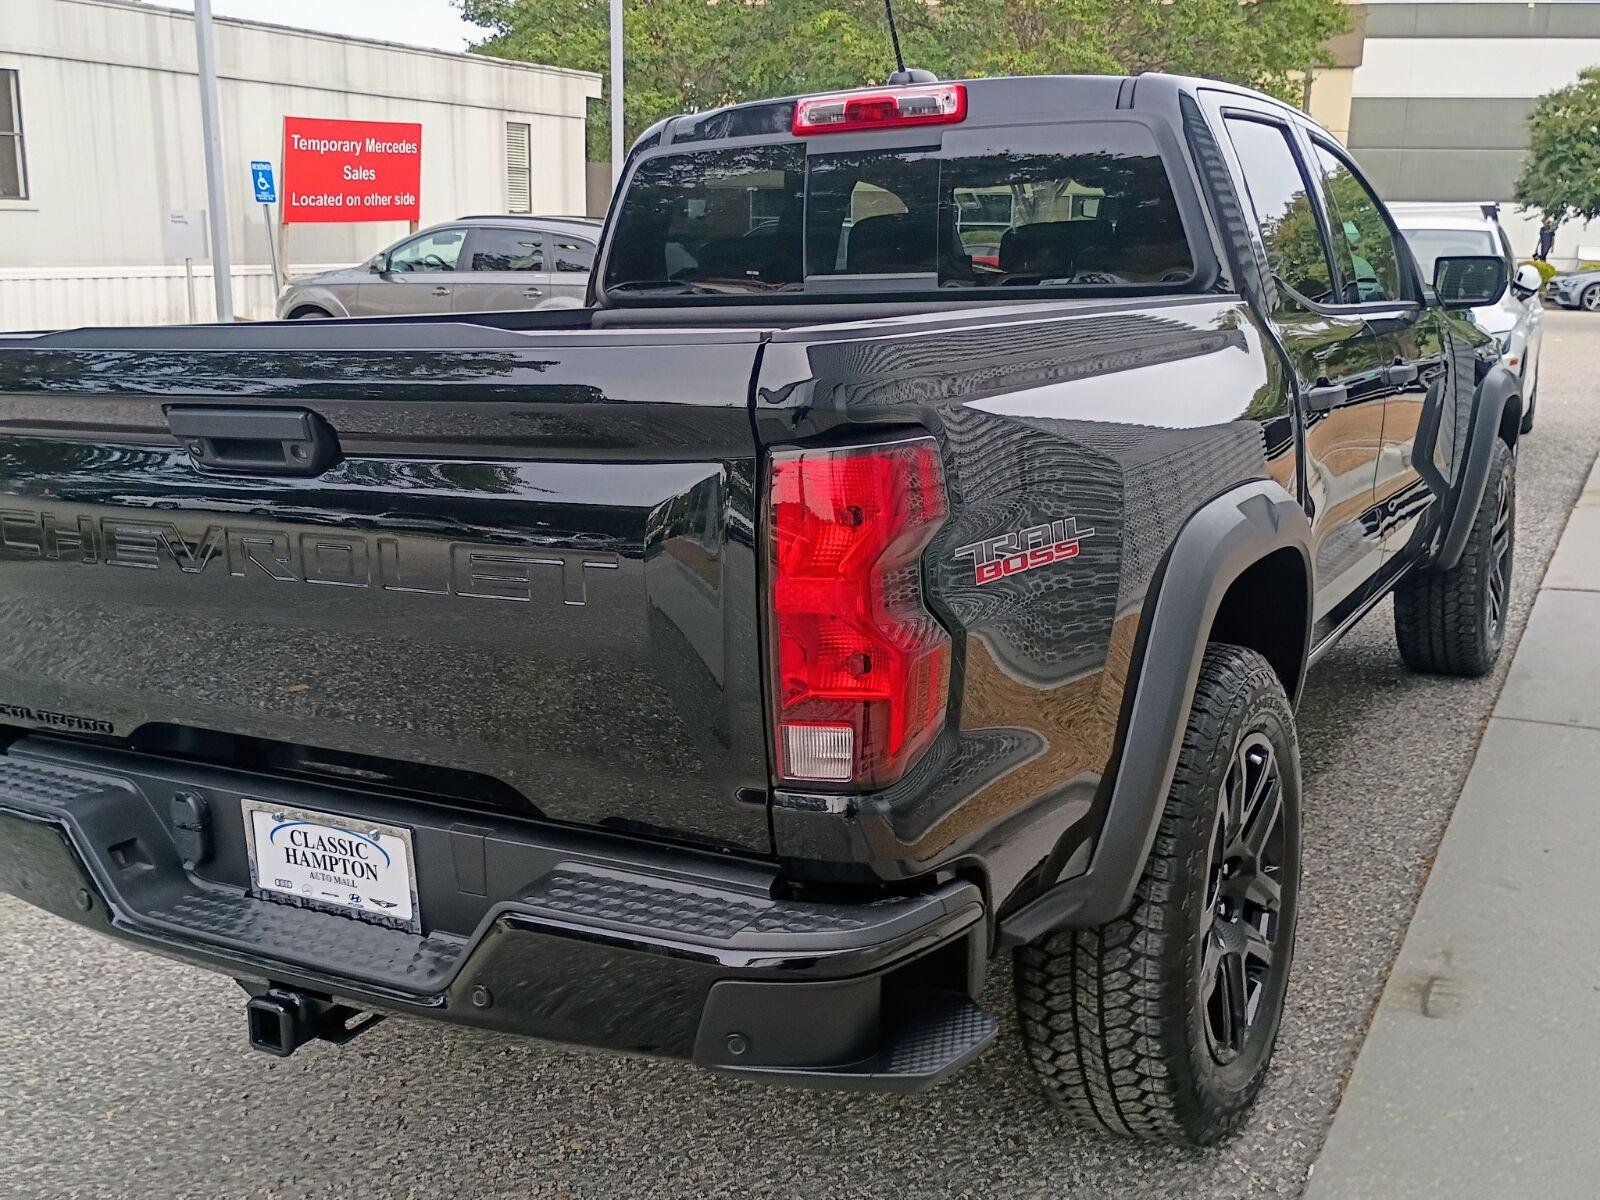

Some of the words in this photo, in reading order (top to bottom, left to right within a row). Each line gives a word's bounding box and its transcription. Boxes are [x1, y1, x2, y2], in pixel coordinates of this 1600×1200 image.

[291, 133, 362, 156] Temporary
[365, 138, 418, 154] Mercedes
[343, 165, 376, 181] Sales
[291, 191, 343, 207] Located
[346, 195, 361, 207] on
[363, 193, 392, 206] other
[394, 192, 416, 205] side
[955, 516, 1095, 564] TRAIL
[0, 507, 619, 606] CHEVROLET
[975, 538, 1080, 586] BOSS
[289, 829, 370, 860] CLASSIC
[284, 846, 379, 882] HAMPTON
[308, 871, 333, 884] AUTO
[334, 875, 358, 889] MALL
